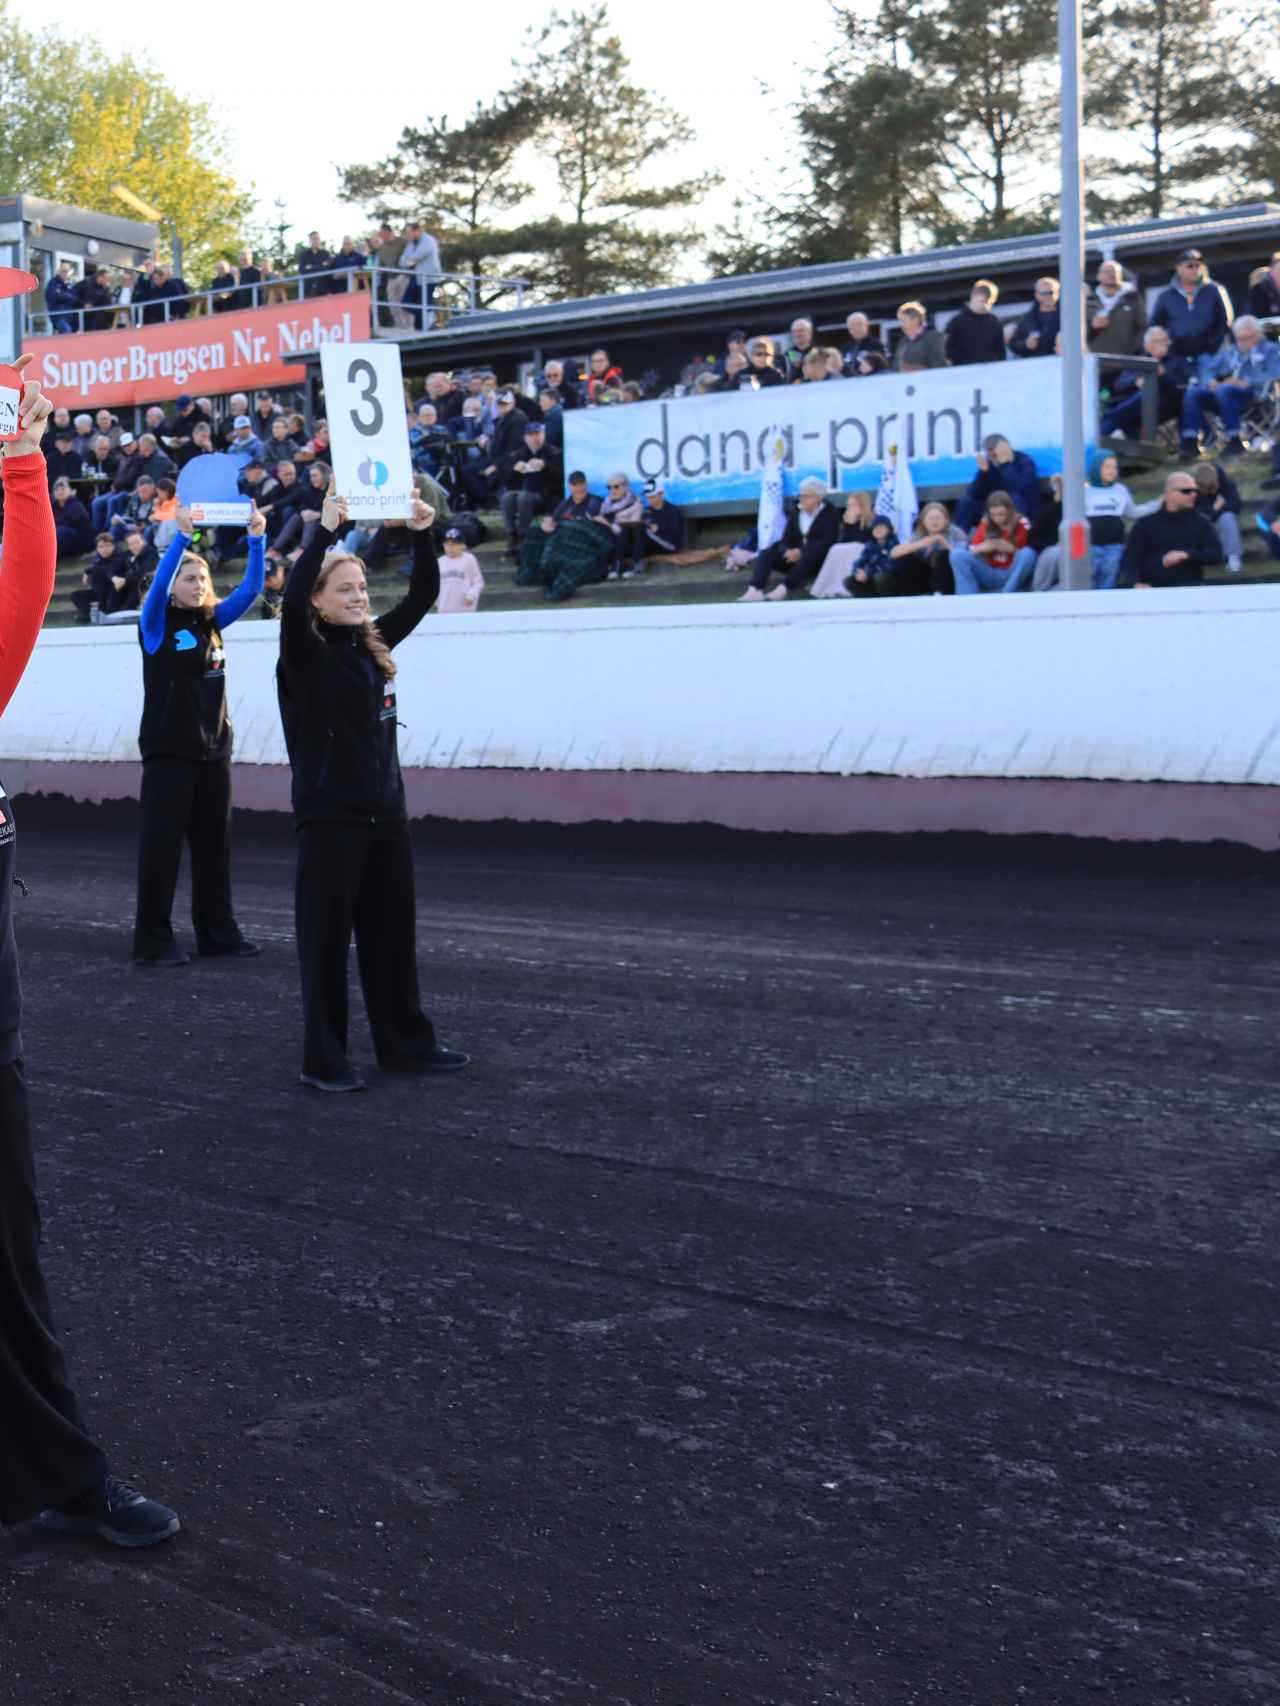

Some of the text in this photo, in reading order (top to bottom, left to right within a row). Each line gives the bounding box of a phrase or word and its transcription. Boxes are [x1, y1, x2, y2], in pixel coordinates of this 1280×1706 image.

[42, 312, 352, 396] SuperBrugsen Nr. Nebel
[347, 358, 384, 436] 3
[634, 385, 991, 490] dana-print
